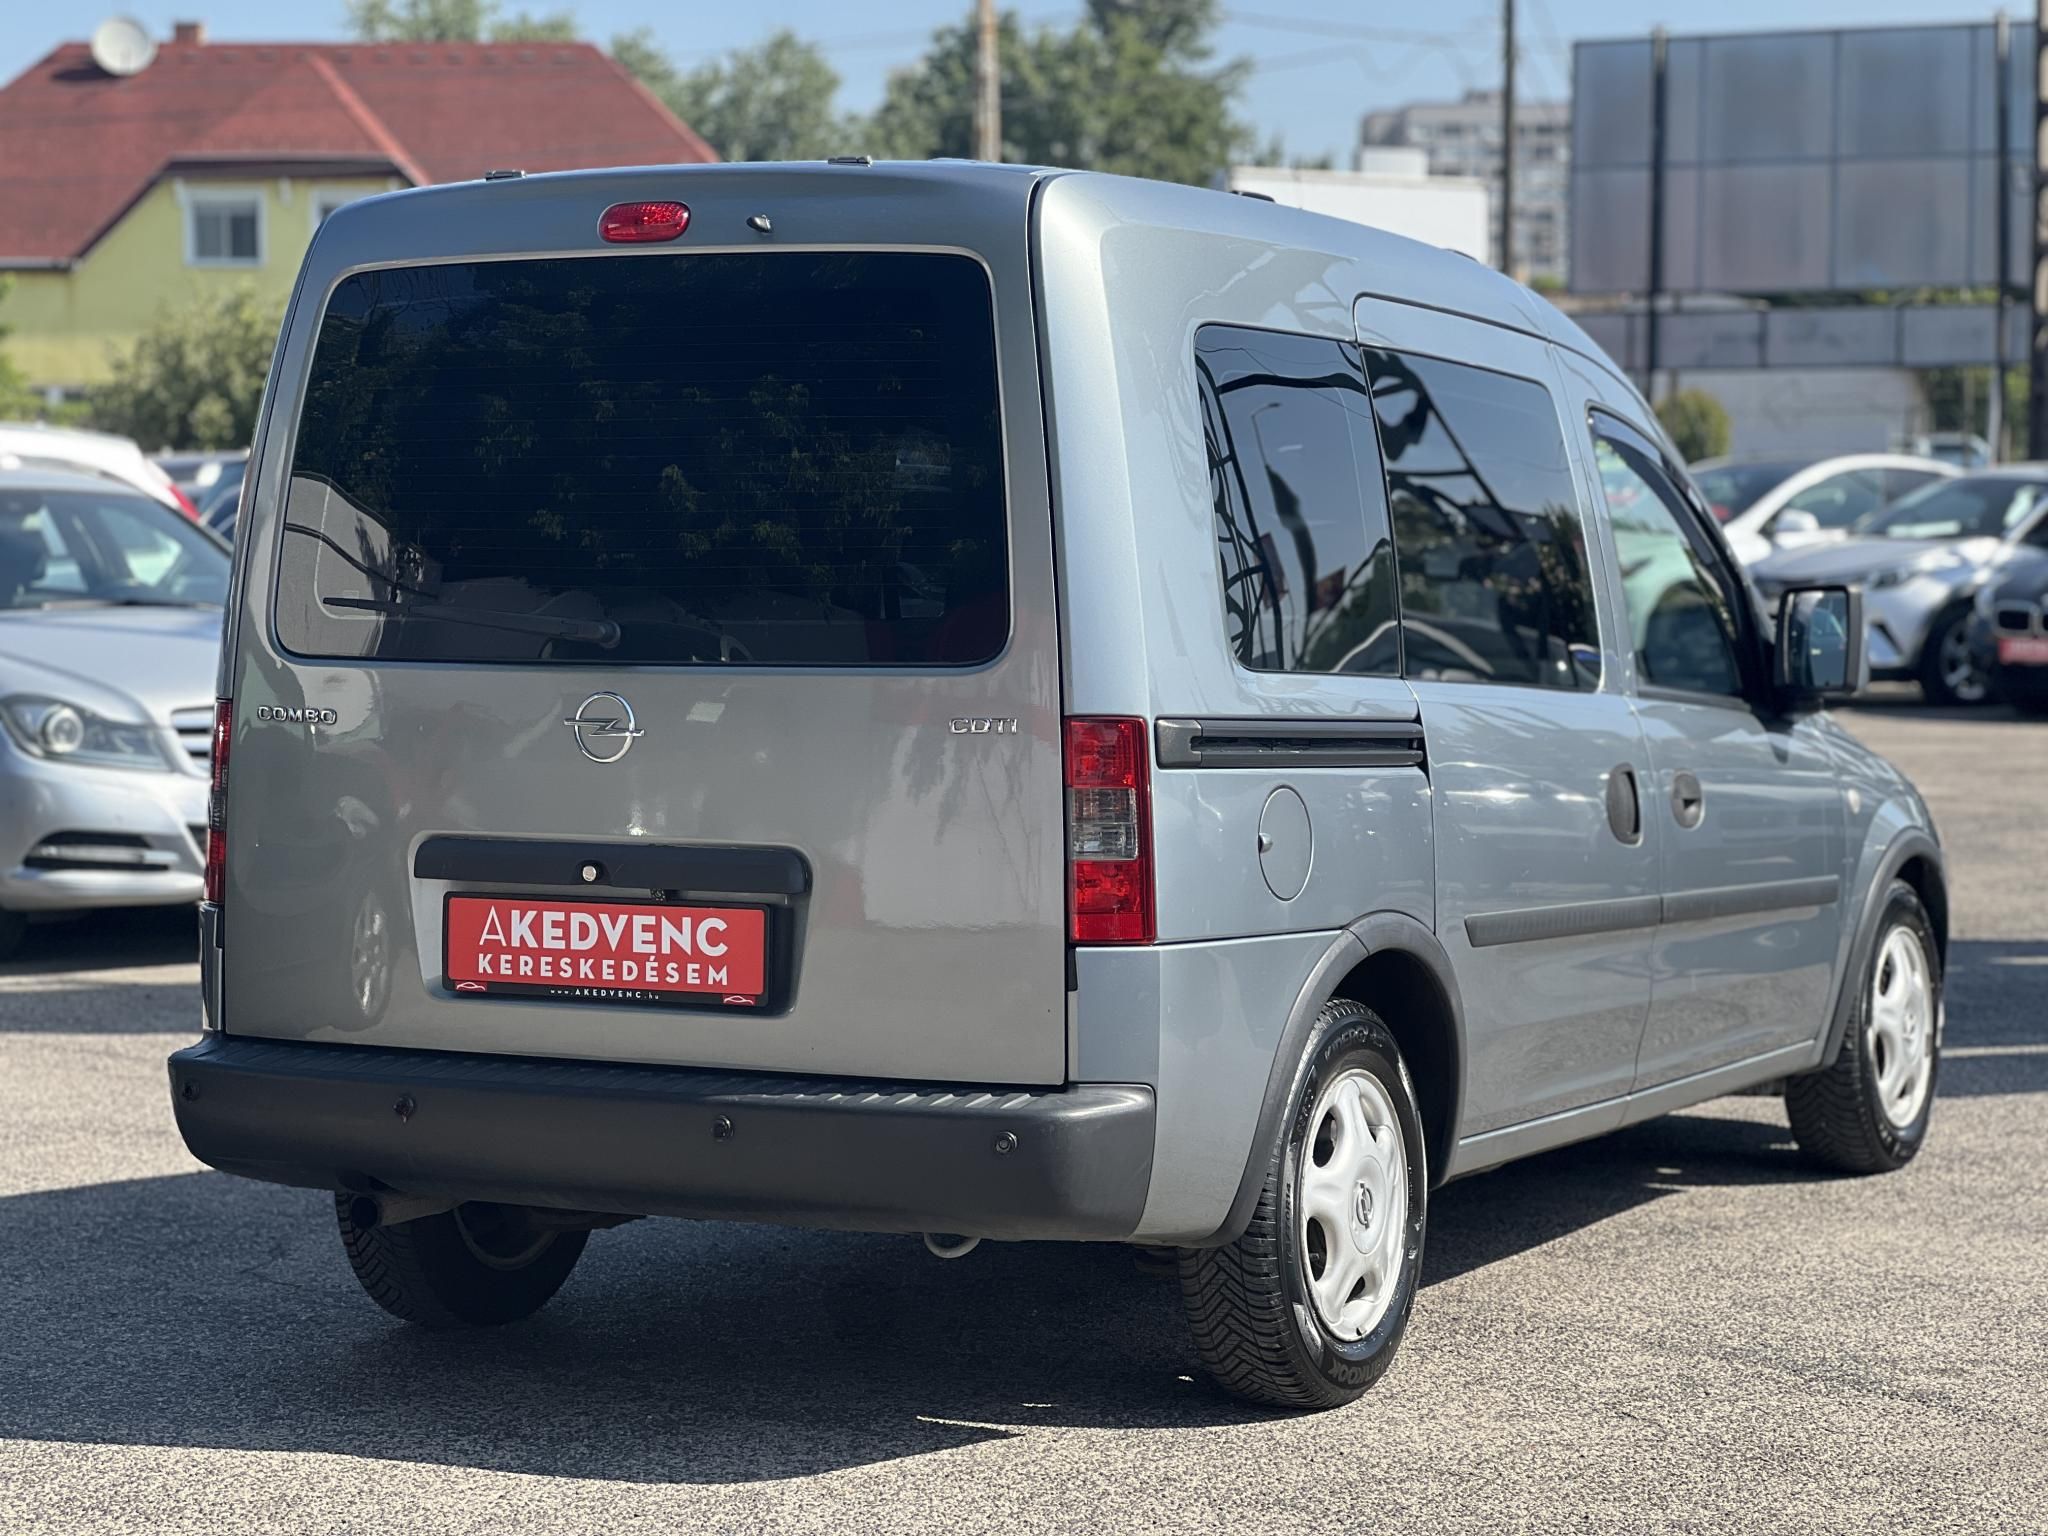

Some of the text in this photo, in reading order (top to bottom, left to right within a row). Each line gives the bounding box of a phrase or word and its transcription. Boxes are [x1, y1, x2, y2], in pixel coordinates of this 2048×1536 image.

[257, 704, 337, 725] COMBO
[948, 717, 1018, 734] CDTI
[479, 906, 728, 956] AKEDVENC
[478, 954, 728, 985] KERESKEDÉSEM
